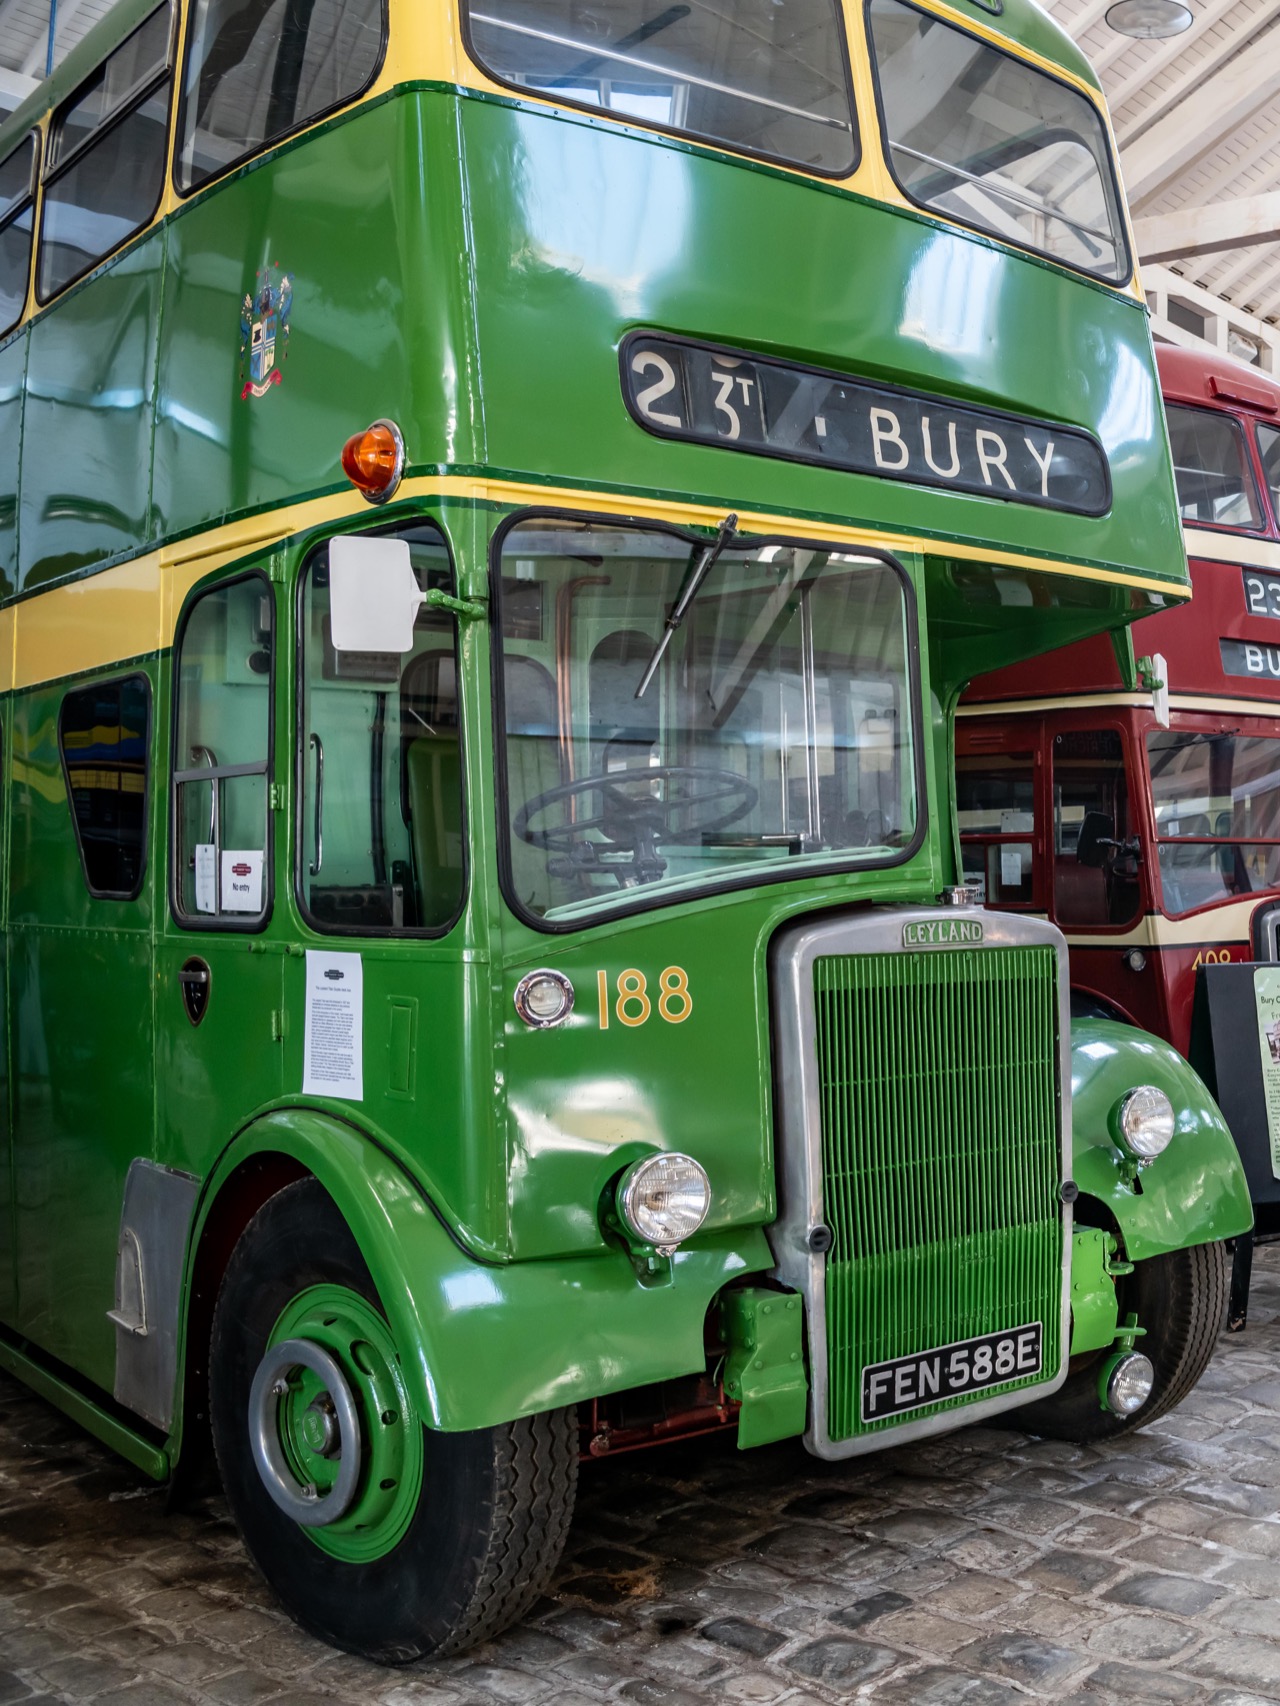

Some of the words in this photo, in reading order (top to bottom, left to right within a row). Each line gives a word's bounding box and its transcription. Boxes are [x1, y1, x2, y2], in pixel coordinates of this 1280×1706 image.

[870, 407, 1055, 497] BURY
[233, 882, 239, 891] No
[239, 883, 250, 894] entry
[907, 920, 982, 943] LEYLAND
[597, 965, 693, 1030] 188
[1260, 996, 1275, 1005] Bury
[869, 1357, 940, 1412] FEN
[949, 1331, 1036, 1388] 588E
